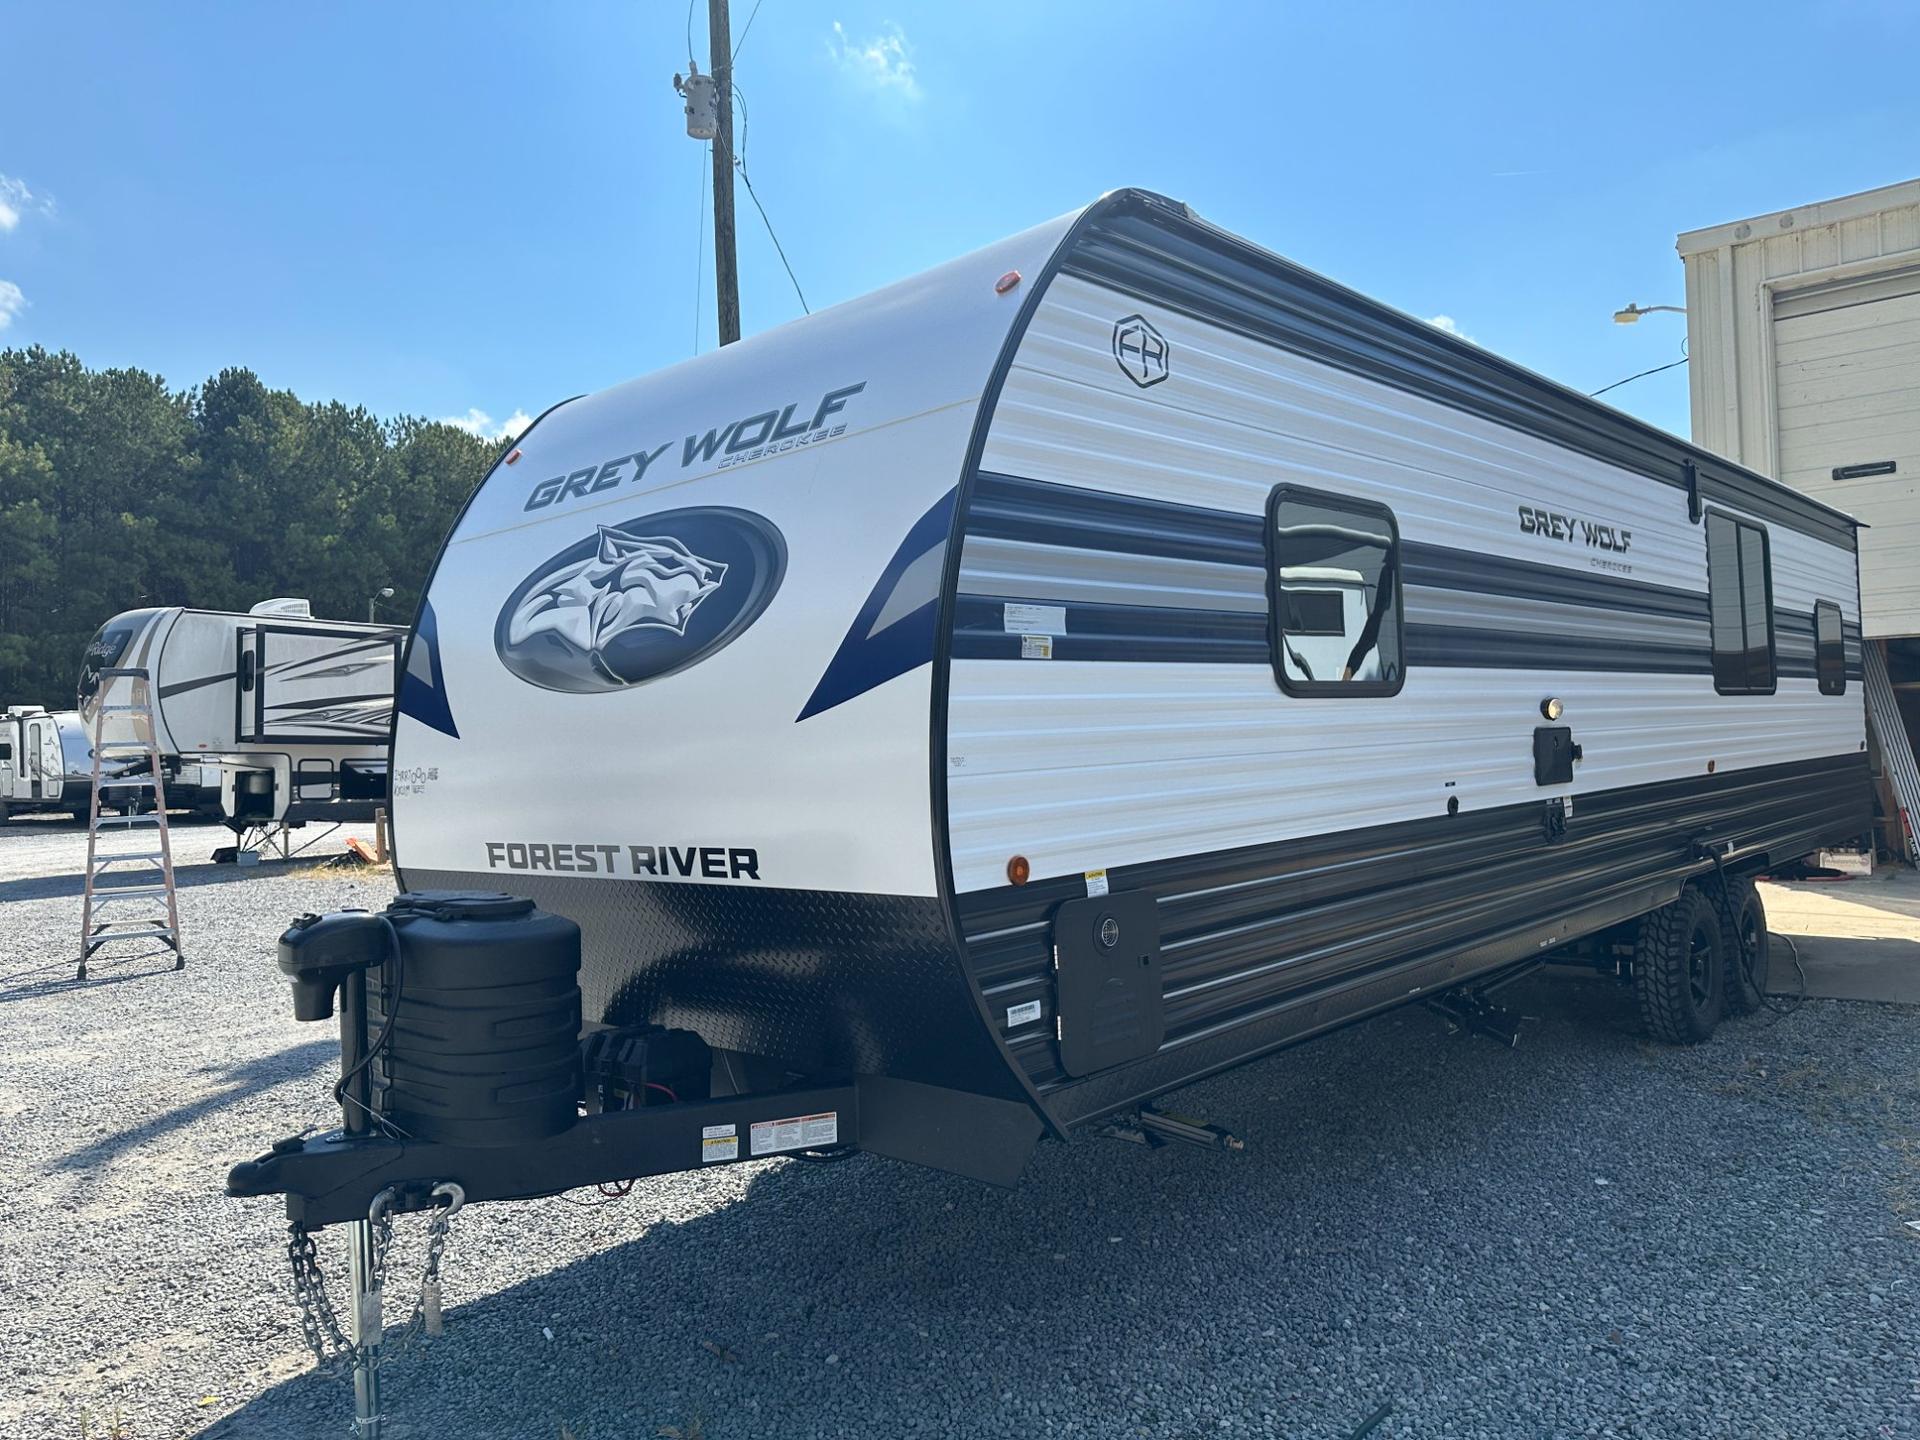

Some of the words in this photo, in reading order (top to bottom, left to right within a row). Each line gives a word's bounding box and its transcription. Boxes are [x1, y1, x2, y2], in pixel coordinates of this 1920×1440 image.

[524, 441, 674, 512] GREY
[681, 381, 867, 468] WOLF
[717, 423, 848, 469] CHEROKEE
[1518, 505, 1577, 543] GREY
[1580, 520, 1632, 554] WOLF
[486, 842, 620, 874] FOREST
[628, 845, 761, 881] RIVER
